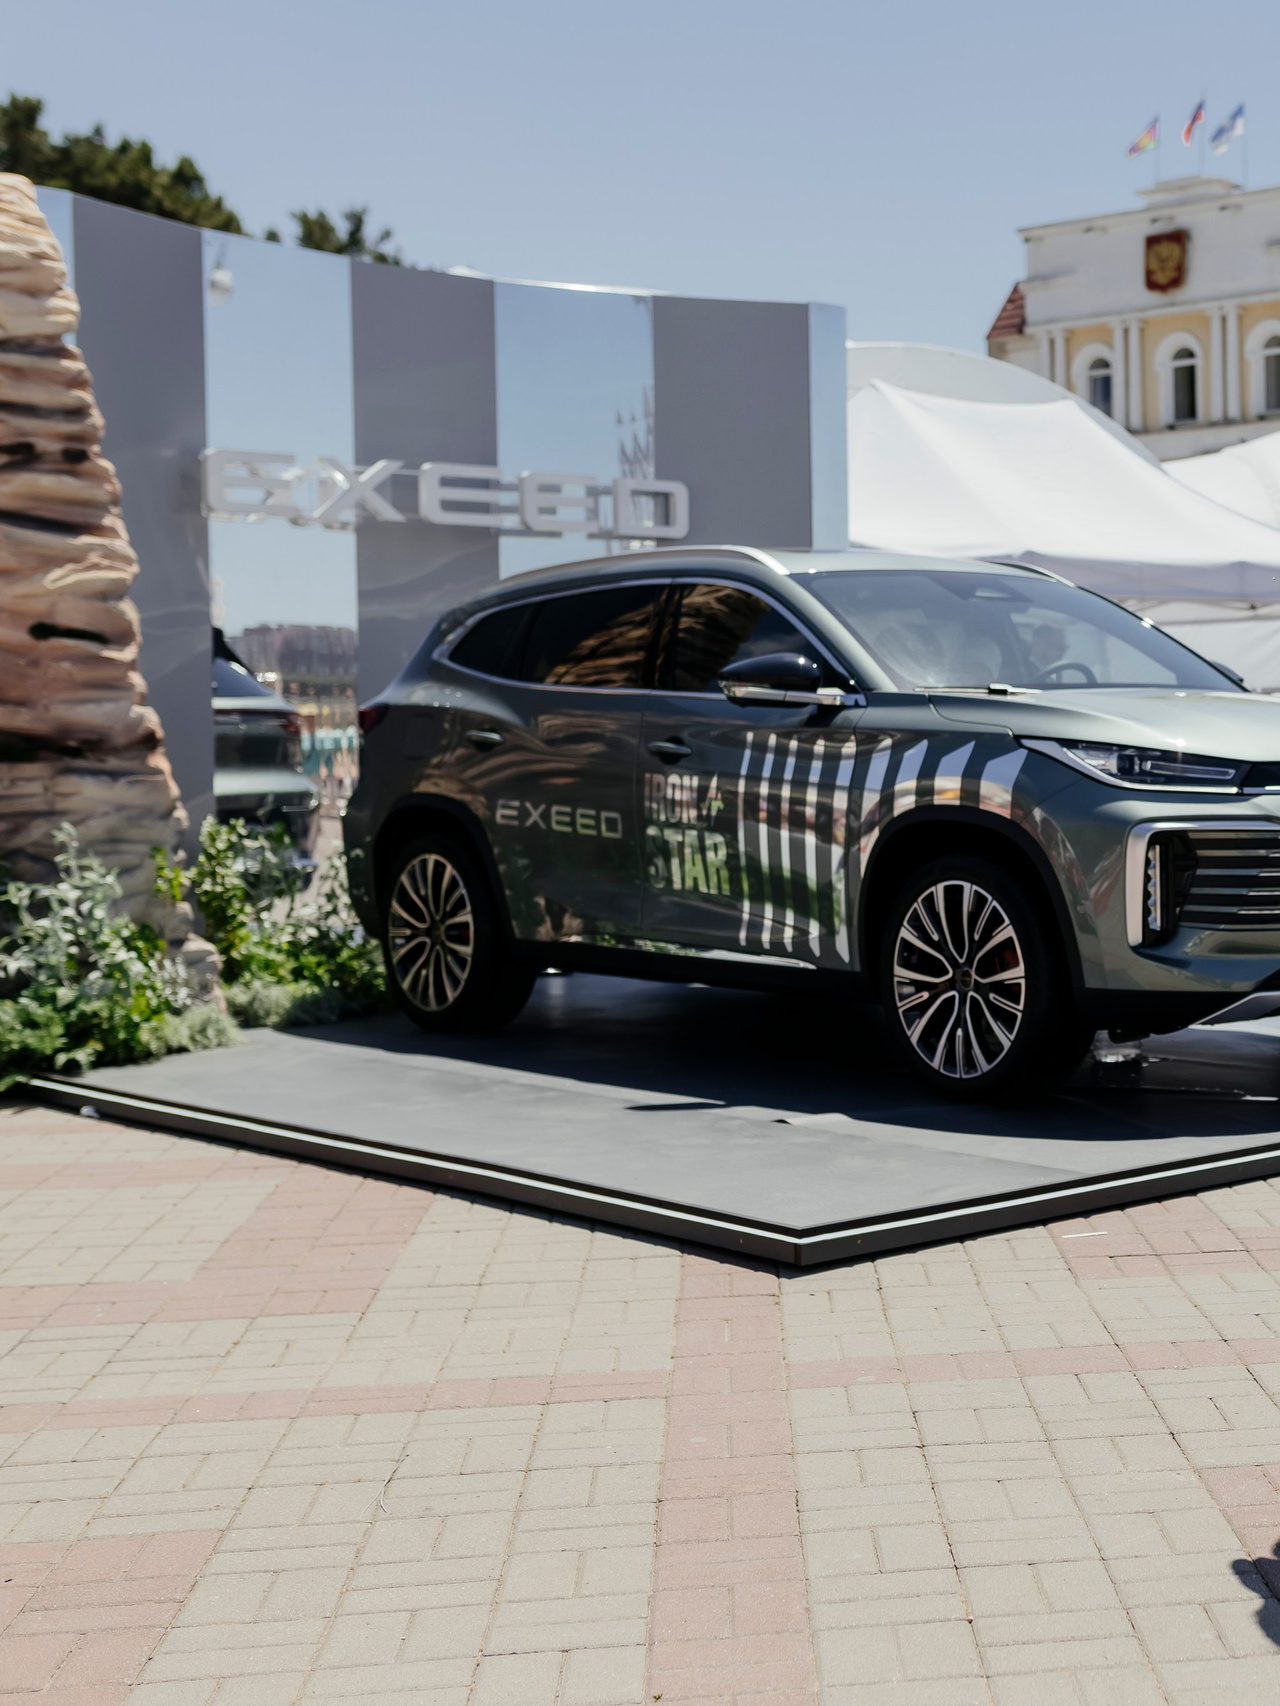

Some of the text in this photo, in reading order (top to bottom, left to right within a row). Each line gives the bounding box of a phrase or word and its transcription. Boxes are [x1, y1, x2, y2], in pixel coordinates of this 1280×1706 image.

[204, 447, 690, 540] EXEED
[495, 798, 623, 839] EXEED
[644, 766, 699, 824] IRON
[646, 824, 730, 896] STAR
